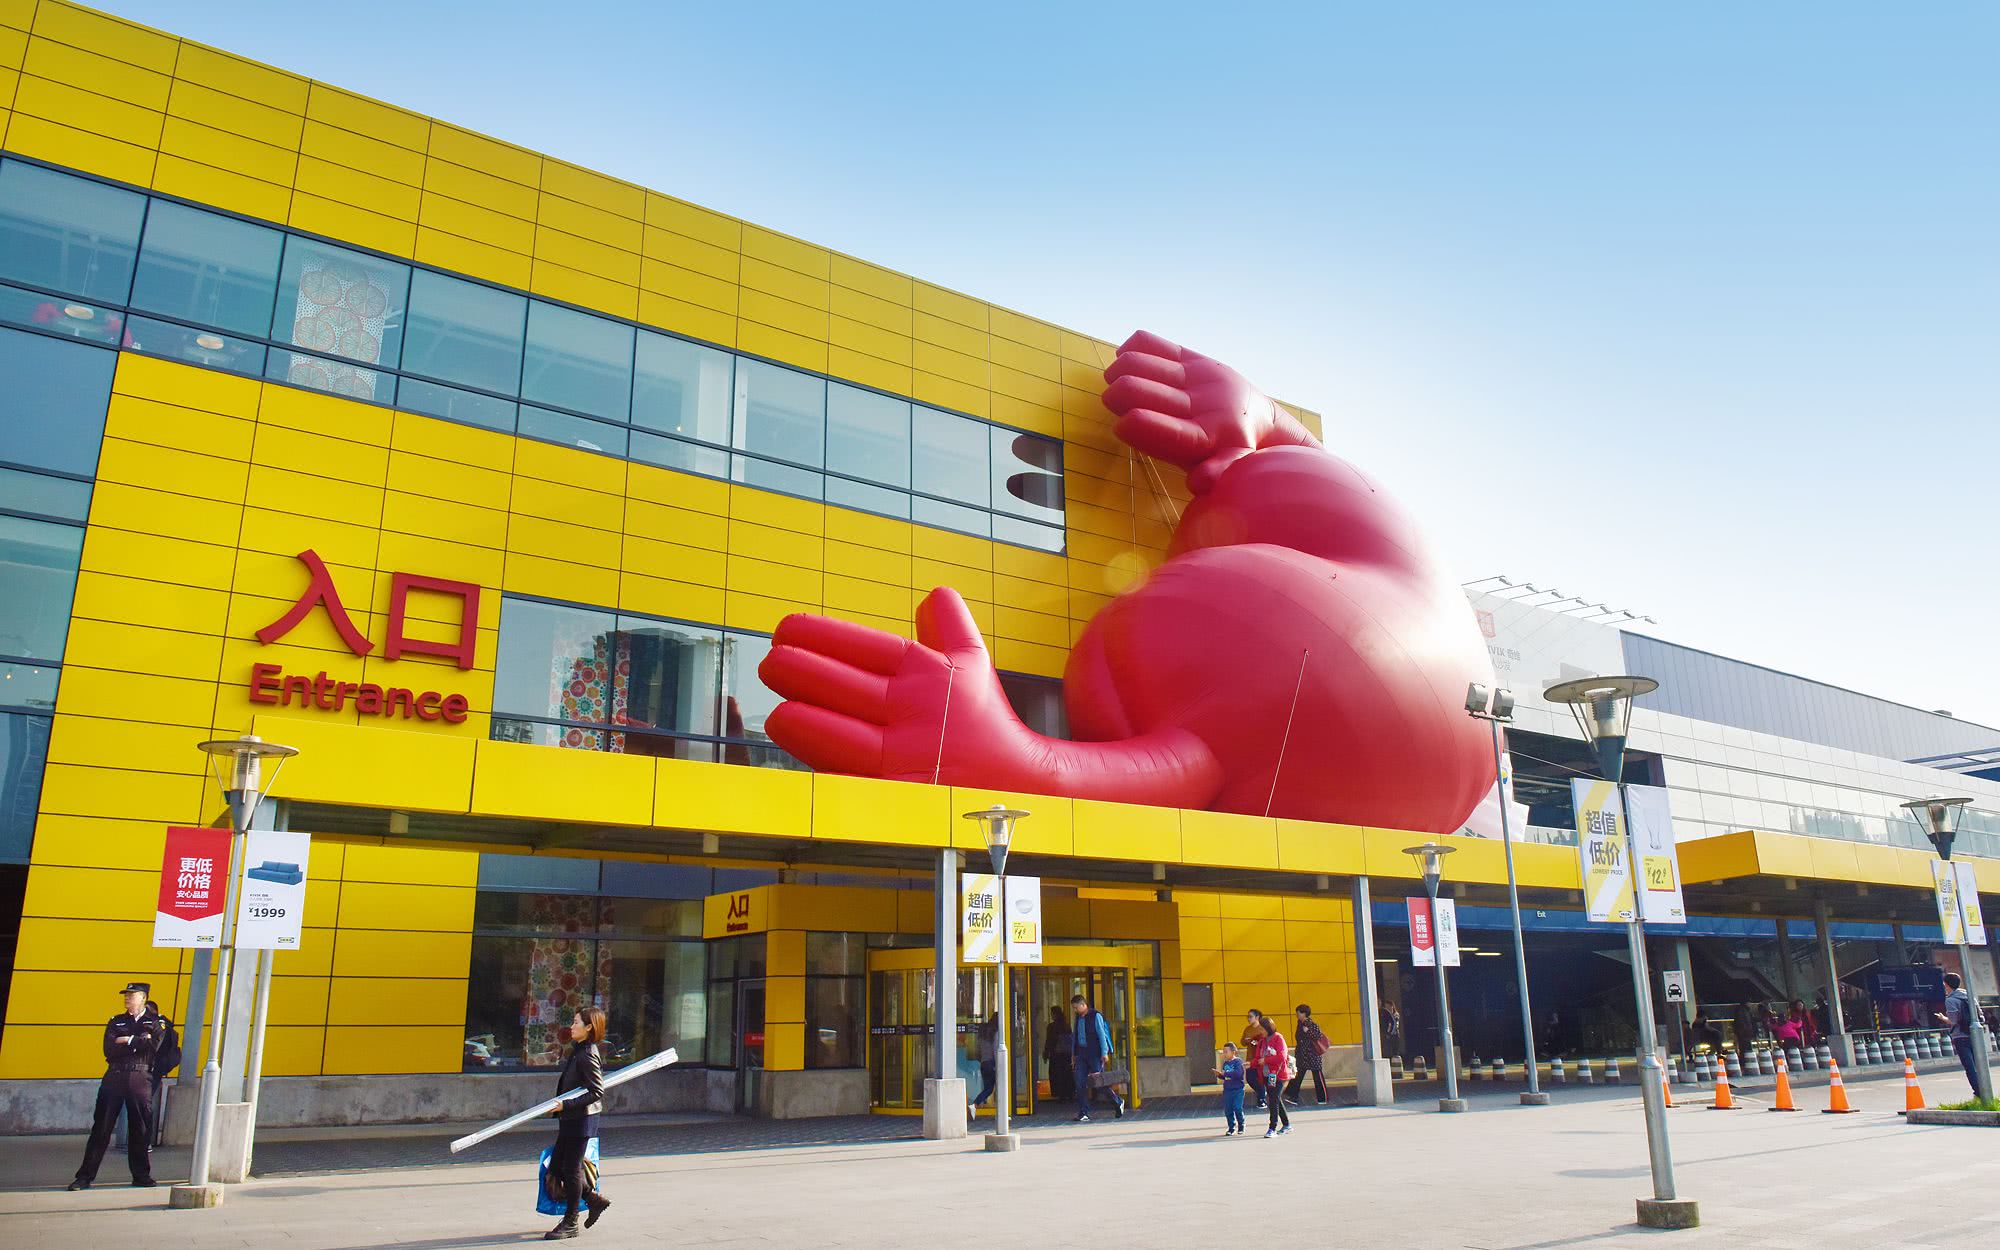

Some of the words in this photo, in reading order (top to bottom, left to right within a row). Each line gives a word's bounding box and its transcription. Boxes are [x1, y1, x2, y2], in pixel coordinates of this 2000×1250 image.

[255, 549, 481, 671] 入口
[1487, 645, 1505, 657] IVIK
[249, 662, 469, 723] Entrance
[1585, 809, 1618, 836] 超值
[1588, 840, 1620, 867] 低价
[179, 857, 213, 874] 更低
[1610, 868, 1623, 876] PRICE
[177, 873, 212, 890] 价格
[176, 890, 209, 899] 安心品质
[968, 892, 993, 909] 超值
[249, 907, 286, 918] ¥1999
[727, 894, 749, 920] 入口
[968, 912, 993, 928] 低价
